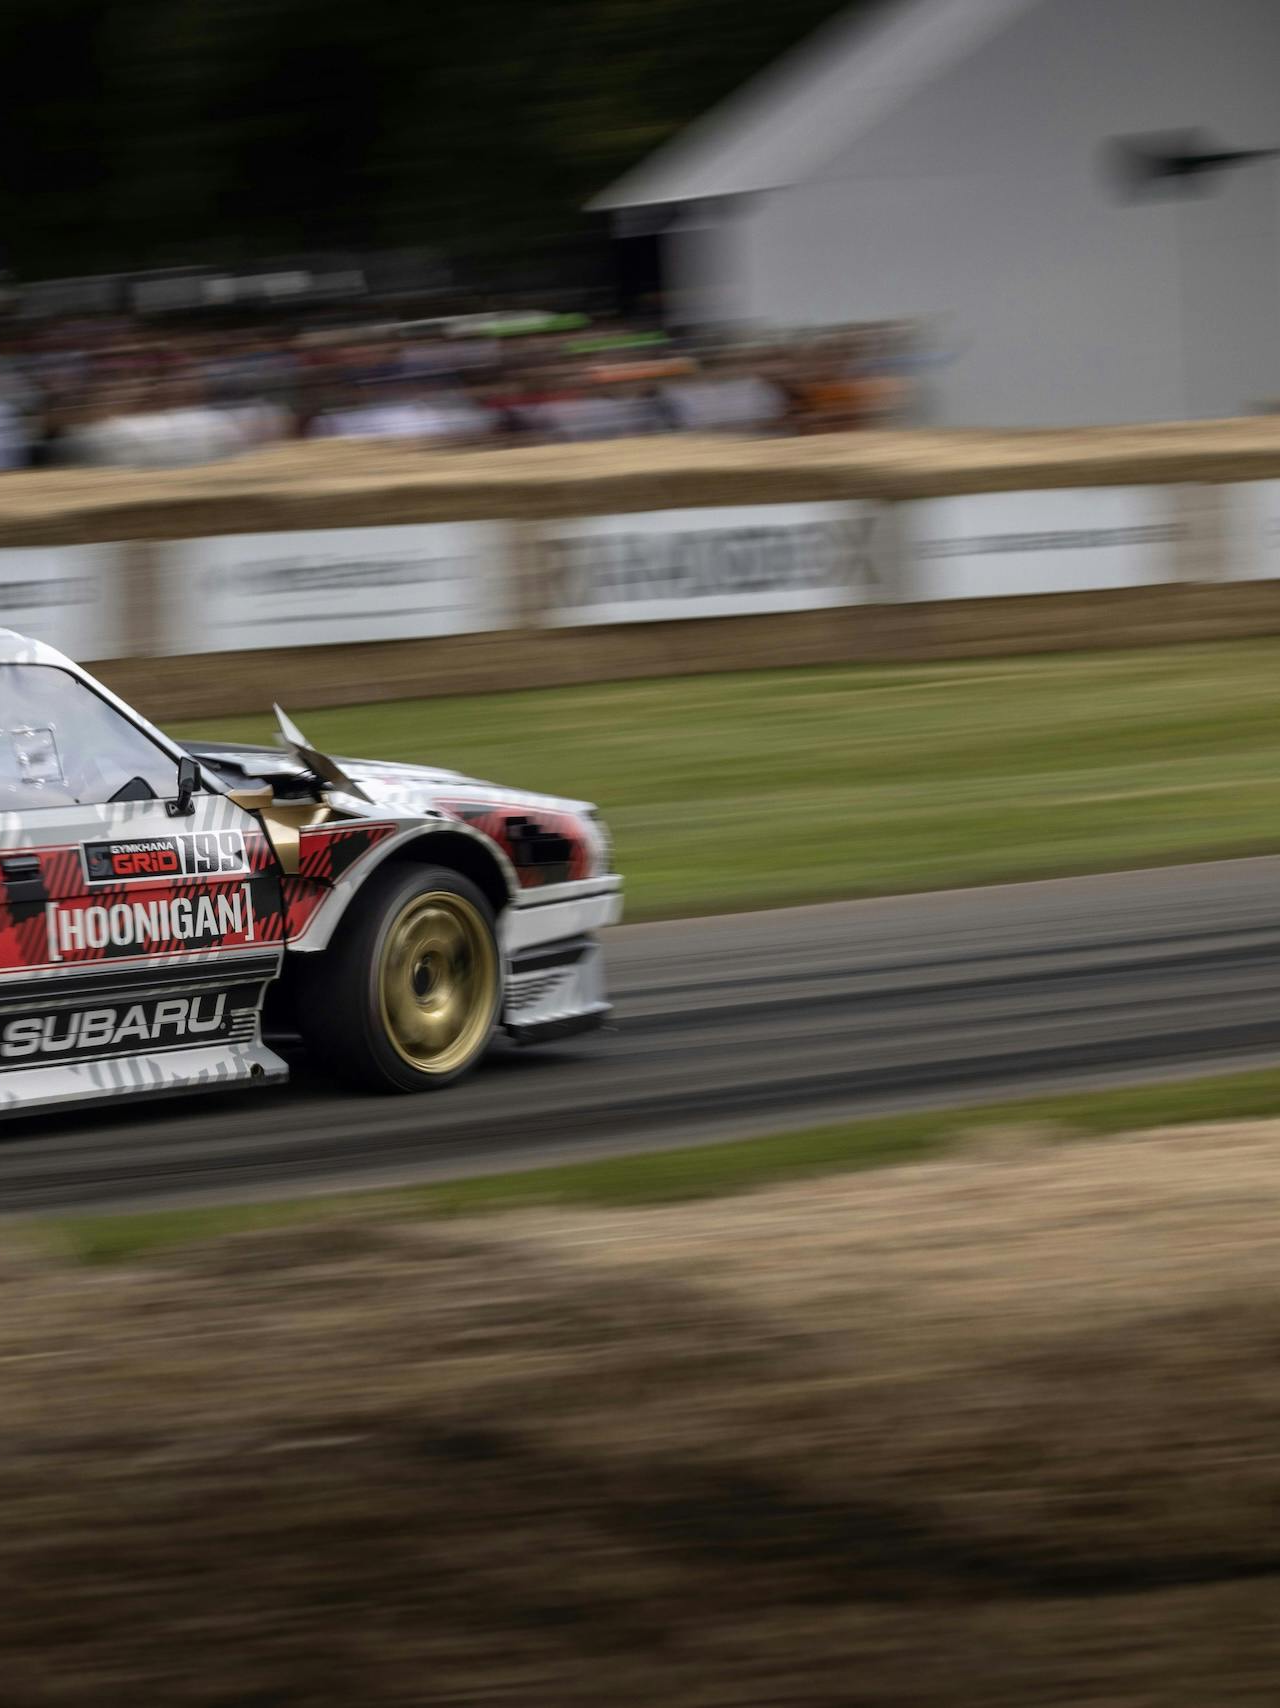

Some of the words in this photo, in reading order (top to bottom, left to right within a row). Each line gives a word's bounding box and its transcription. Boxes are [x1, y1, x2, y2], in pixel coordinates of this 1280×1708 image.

[109, 841, 175, 855] GYMKHANA
[178, 832, 244, 875] 199
[0, 994, 227, 1057] SUBARU
